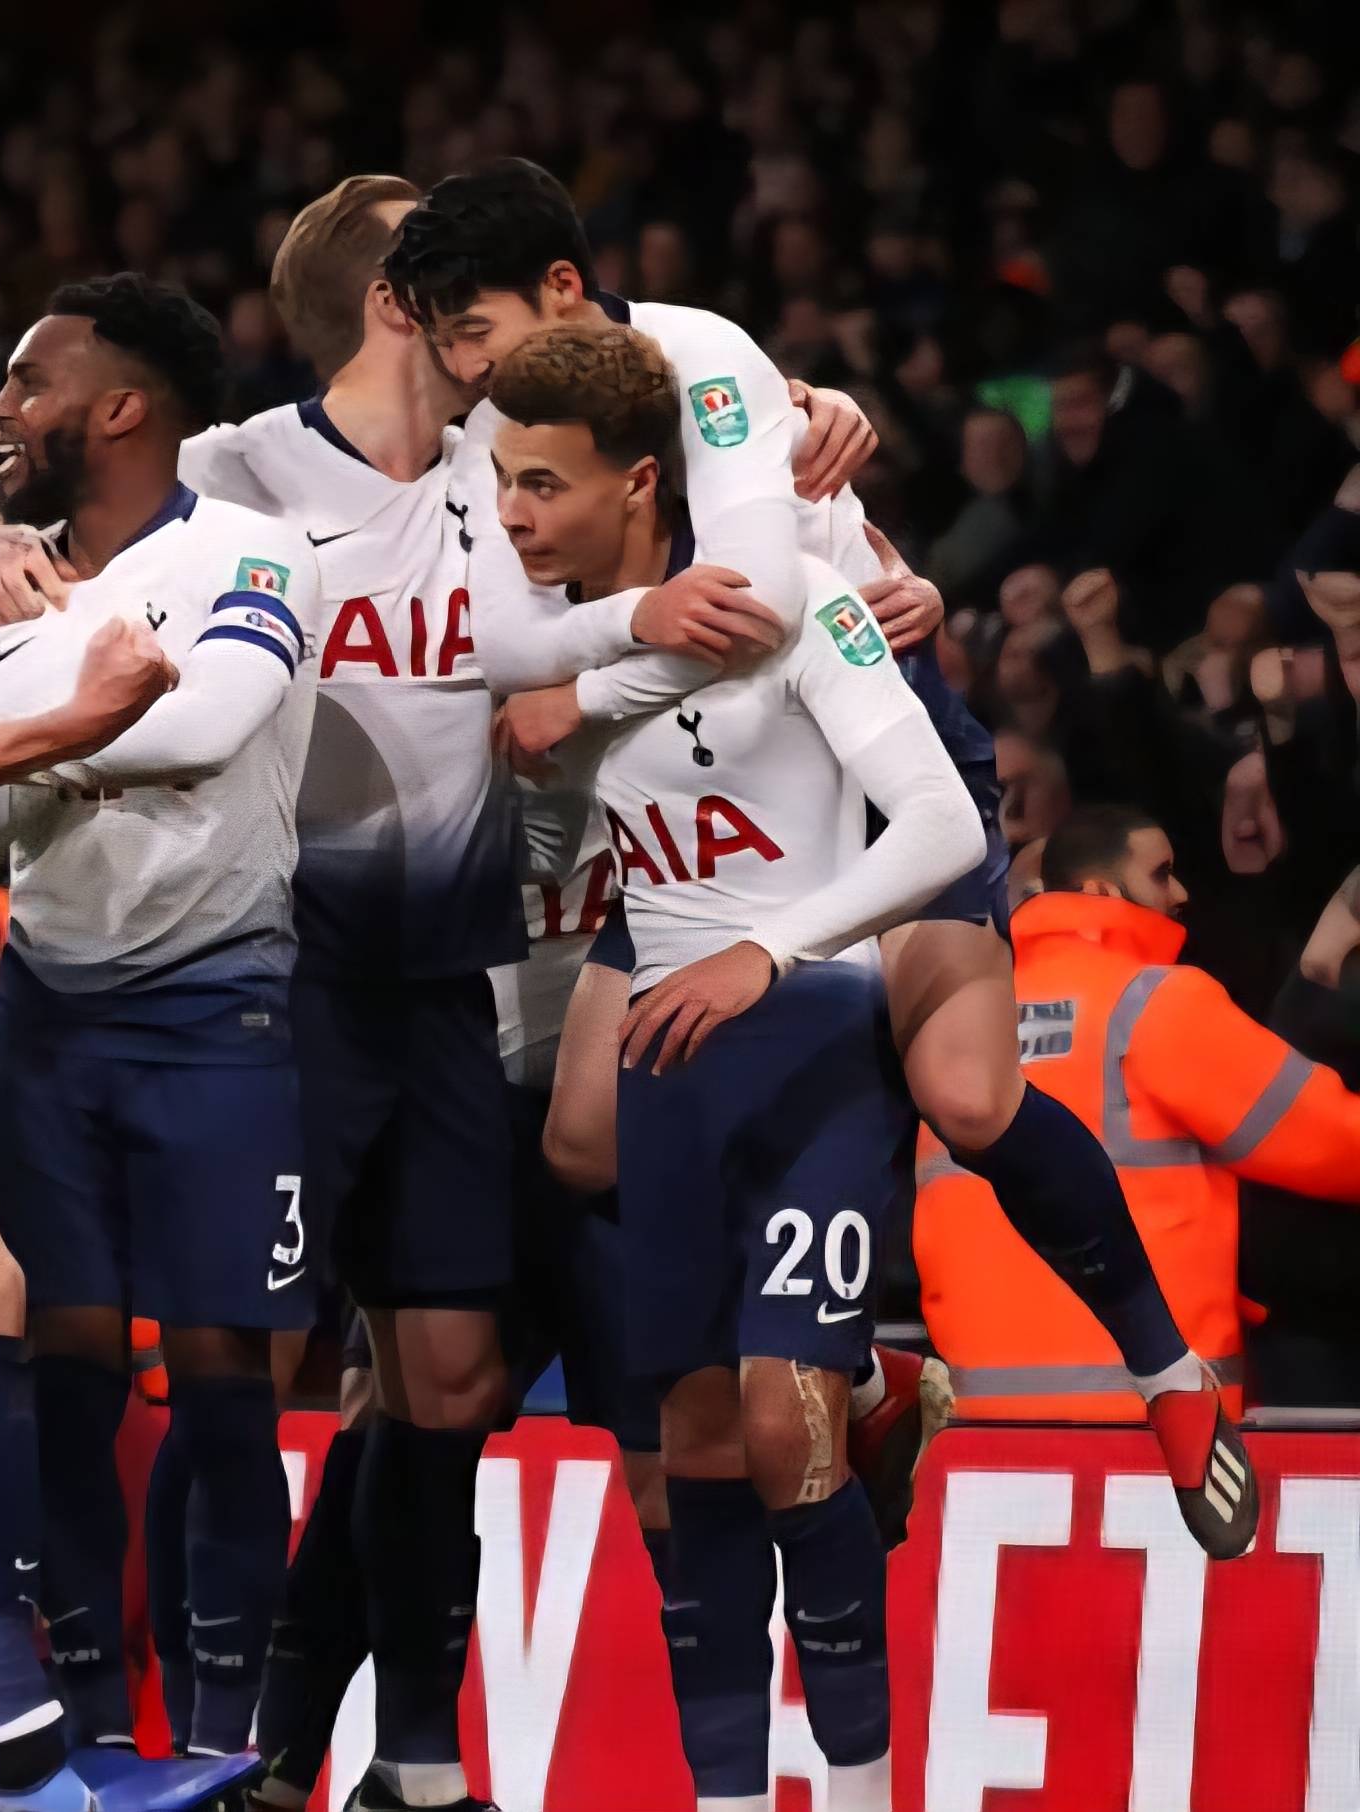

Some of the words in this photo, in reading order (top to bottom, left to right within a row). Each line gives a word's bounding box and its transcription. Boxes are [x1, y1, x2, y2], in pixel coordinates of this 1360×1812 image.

[605, 794, 785, 886] AIA
[272, 1174, 304, 1265] 3
[760, 1207, 871, 1300] 20
